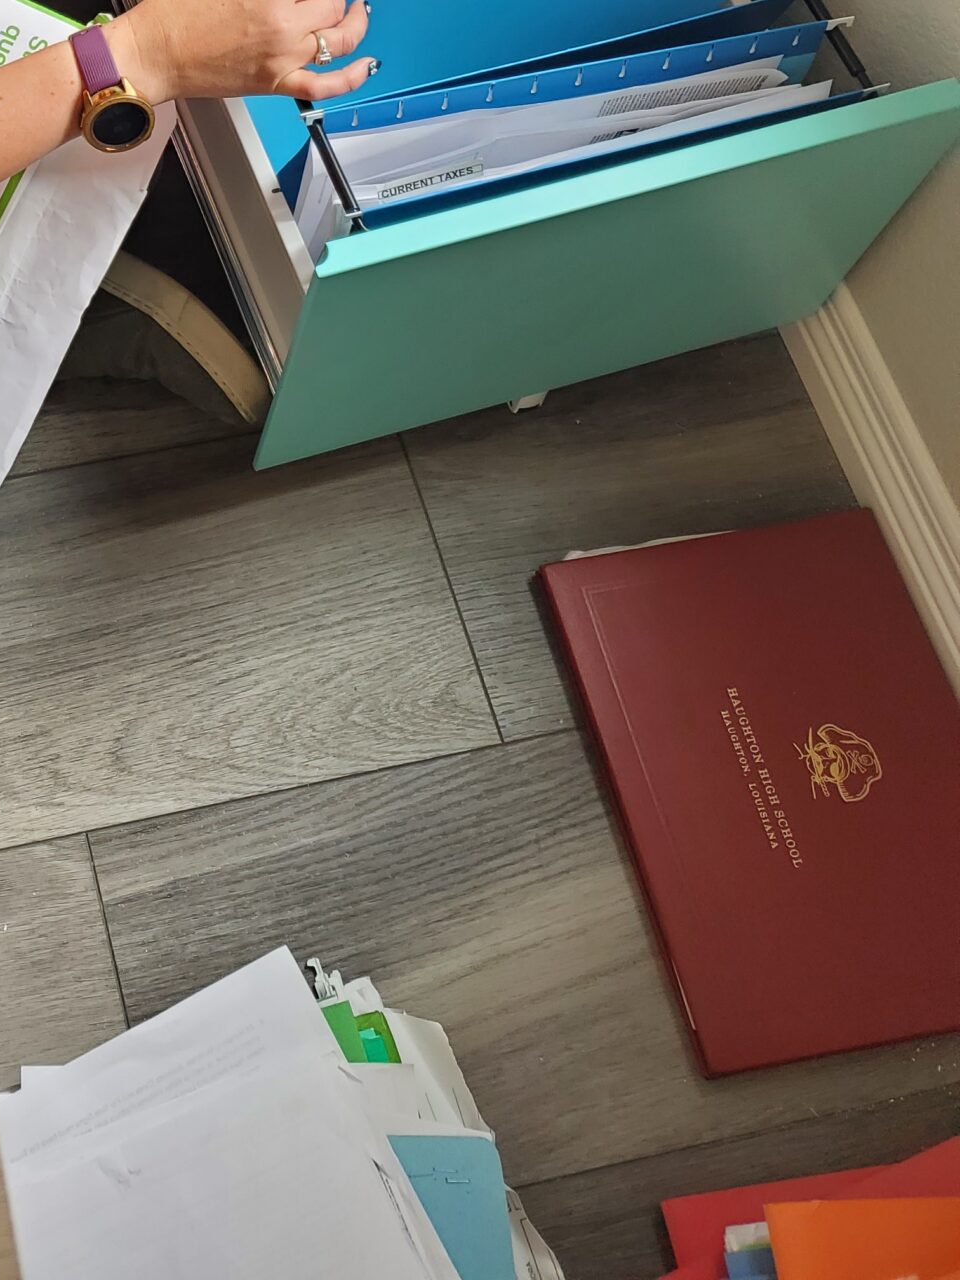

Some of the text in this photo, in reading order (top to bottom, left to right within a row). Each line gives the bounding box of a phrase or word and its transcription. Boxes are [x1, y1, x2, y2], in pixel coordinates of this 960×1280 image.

[381, 166, 474, 199] CURRENT TAXES
[721, 710, 780, 850] HAUGHTON, LOUISIANA
[726, 686, 804, 869] HAUGHTON HIGH SCHOOL
